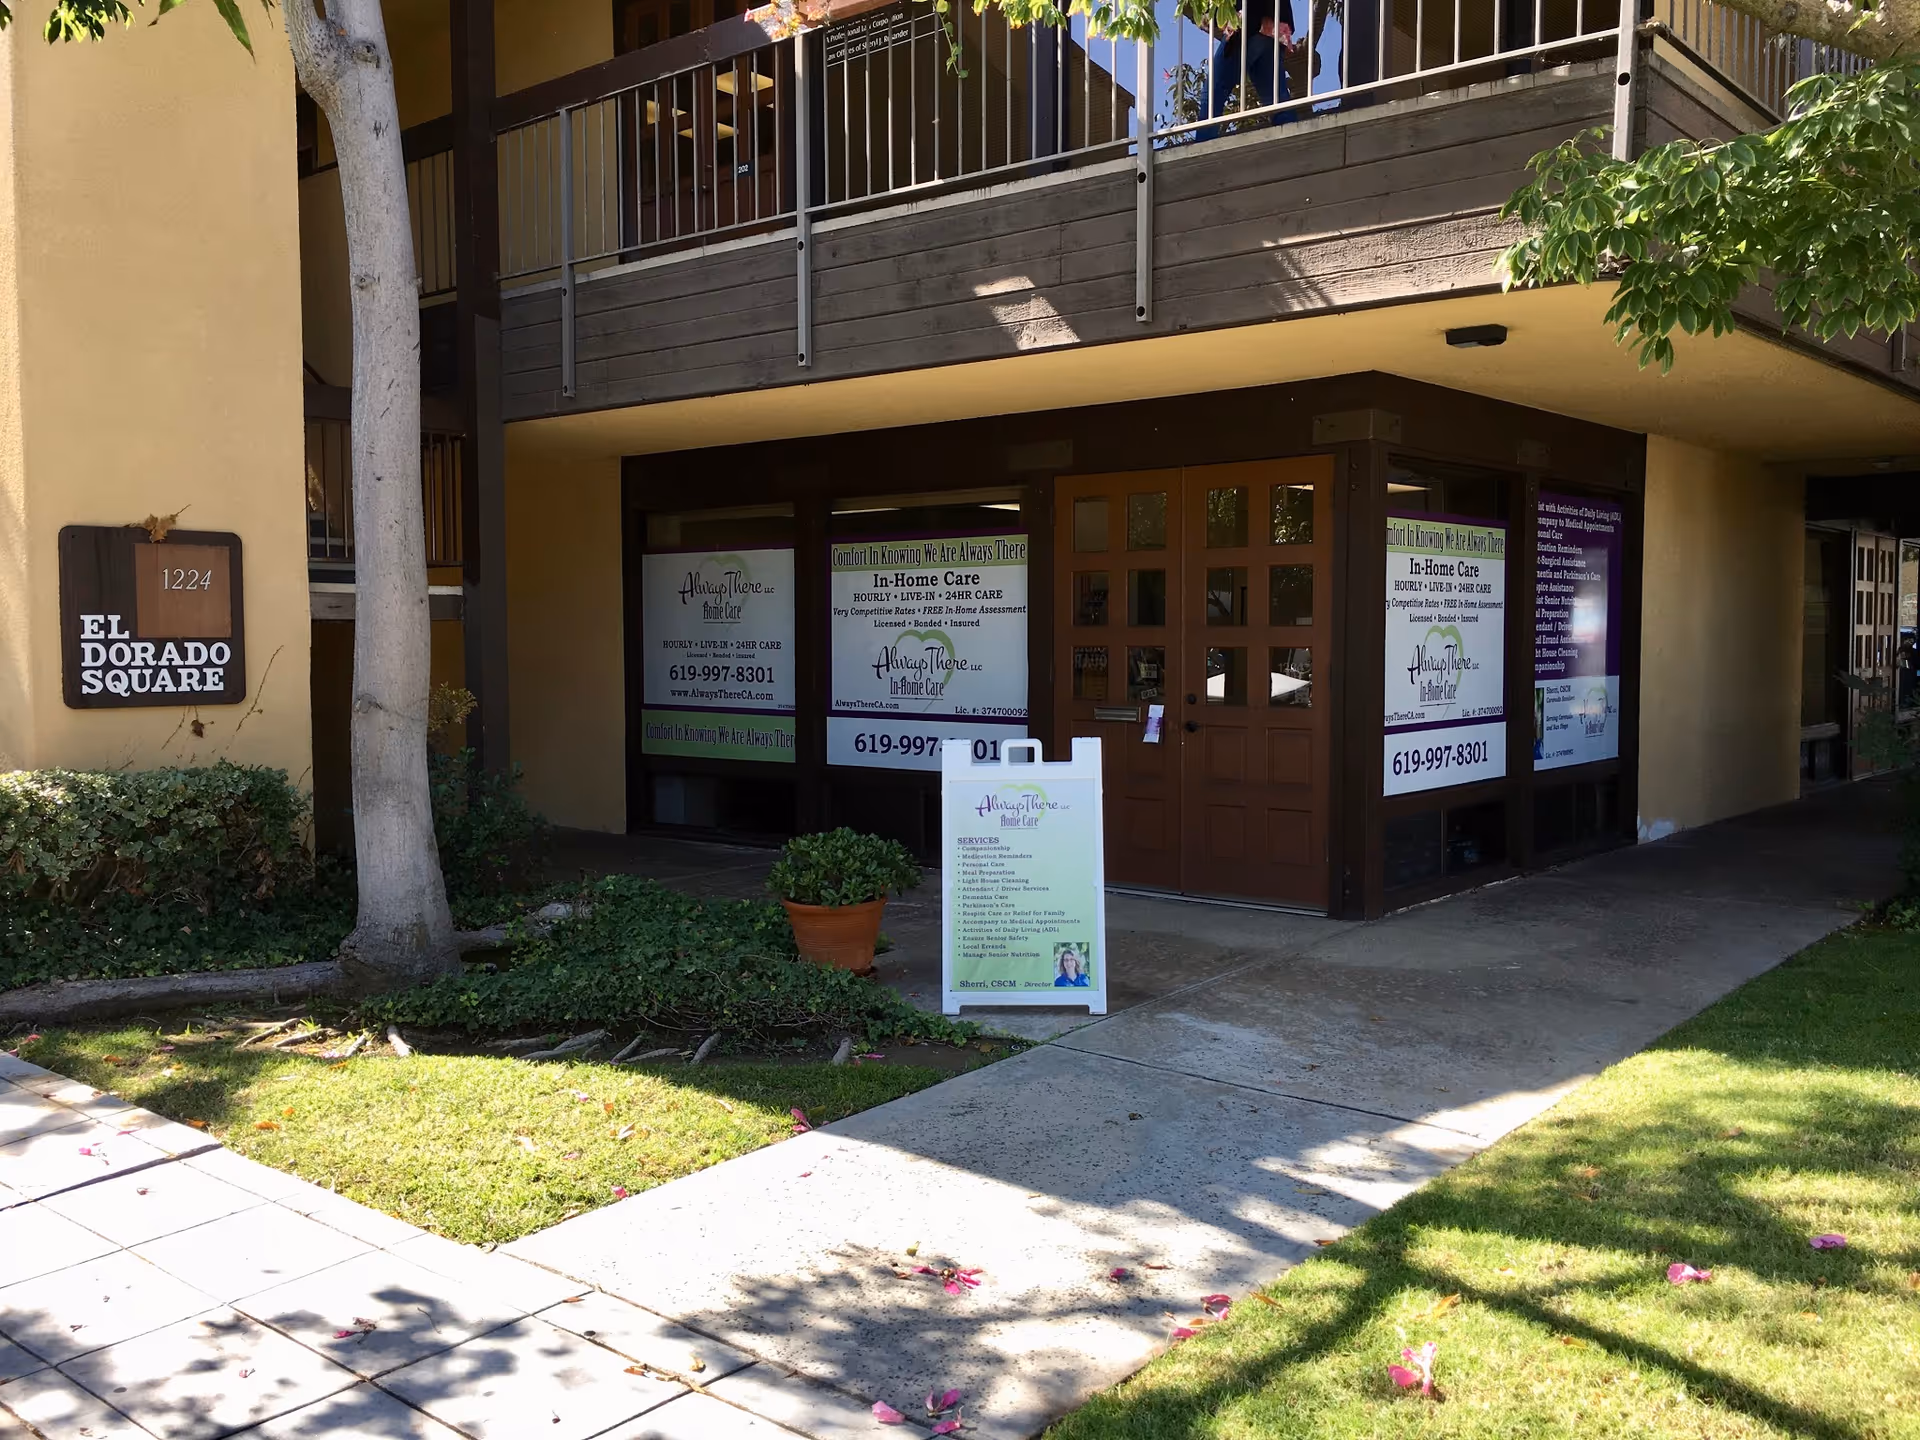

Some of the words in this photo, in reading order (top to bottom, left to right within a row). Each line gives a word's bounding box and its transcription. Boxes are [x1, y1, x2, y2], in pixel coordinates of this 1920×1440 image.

[855, 42, 862, 52] of
[738, 164, 749, 174] 202
[1407, 523, 1415, 547] In
[1416, 524, 1444, 553] Knowing
[1444, 527, 1455, 550] We
[1456, 528, 1466, 551] Are
[1467, 529, 1487, 556] Always
[1487, 531, 1504, 554] There
[1551, 529, 1563, 540] Care
[833, 546, 867, 567] Comfort
[869, 546, 879, 565] In
[881, 544, 921, 567] Knowing
[923, 543, 937, 563] We
[940, 542, 957, 562] Are
[959, 541, 993, 564] Always
[995, 539, 1026, 560] There
[1409, 557, 1455, 577] In-Home
[1457, 560, 1480, 578] Care
[163, 568, 212, 591] 1224
[873, 572, 938, 588] In-Home
[943, 571, 980, 586] Care
[1394, 580, 1423, 592] HOURLY
[1429, 581, 1453, 593] LIVE-IN
[1458, 582, 1475, 593] 24HR
[1475, 583, 1492, 594] CARE
[853, 592, 891, 602] HOURLY
[900, 591, 936, 601] LIVE-IN
[945, 590, 972, 600] 24HR
[974, 589, 1003, 600] CARE
[1391, 597, 1424, 610] Competitive
[1424, 598, 1440, 608] Rates
[1443, 598, 1457, 609] FREE
[1458, 599, 1478, 609] In-Home
[1478, 600, 1504, 609] Assessment
[703, 601, 724, 620] Home
[725, 602, 742, 620] Care
[833, 607, 849, 617] Very
[850, 606, 893, 617] Competitive
[894, 606, 916, 615] Rates
[922, 606, 943, 615] FREE
[945, 605, 977, 615] In-Home
[978, 604, 1027, 614] Assessment
[873, 619, 906, 628] Licensed
[913, 619, 942, 628] Bonded
[950, 618, 980, 627] Insured
[1409, 613, 1433, 622] Licensed
[1437, 613, 1457, 622] Bonded
[1460, 614, 1479, 623] Insured
[80, 614, 130, 639] EL
[663, 640, 693, 649] HOURLY
[700, 640, 728, 649] LIVE-IN
[735, 640, 757, 650] 24HR
[759, 641, 782, 650] CARE
[80, 641, 232, 667] DORADO
[970, 663, 983, 671] LLC
[669, 664, 775, 684] 619-997-8301
[81, 667, 224, 697] SQUARE
[890, 676, 923, 696] In-Home
[925, 677, 944, 696] Care
[670, 688, 774, 701] www.AlwaysThereCA.com
[1419, 679, 1444, 702] In-Home
[1444, 680, 1457, 700] Care
[834, 699, 900, 710] AlwaysThereCA.com
[955, 706, 970, 715] Lic.
[981, 707, 1028, 717] 374700092
[646, 722, 673, 740] Comfort
[675, 723, 683, 741] In
[684, 724, 717, 746] Knowing
[718, 726, 730, 743] We
[731, 727, 744, 745] Are
[746, 728, 773, 749] Always
[775, 729, 796, 748] Ther
[854, 733, 1001, 761] 619-997-01
[1393, 740, 1488, 776] 619-997-8301
[1000, 814, 1021, 827] Home
[1022, 814, 1039, 827] Care
[957, 837, 1000, 845] SERVICES
[979, 869, 1016, 877] Preparation
[962, 877, 979, 885] Light
[1035, 918, 1081, 926] Appointments
[959, 980, 989, 989] Sherri,
[990, 980, 1017, 988] CSCM
